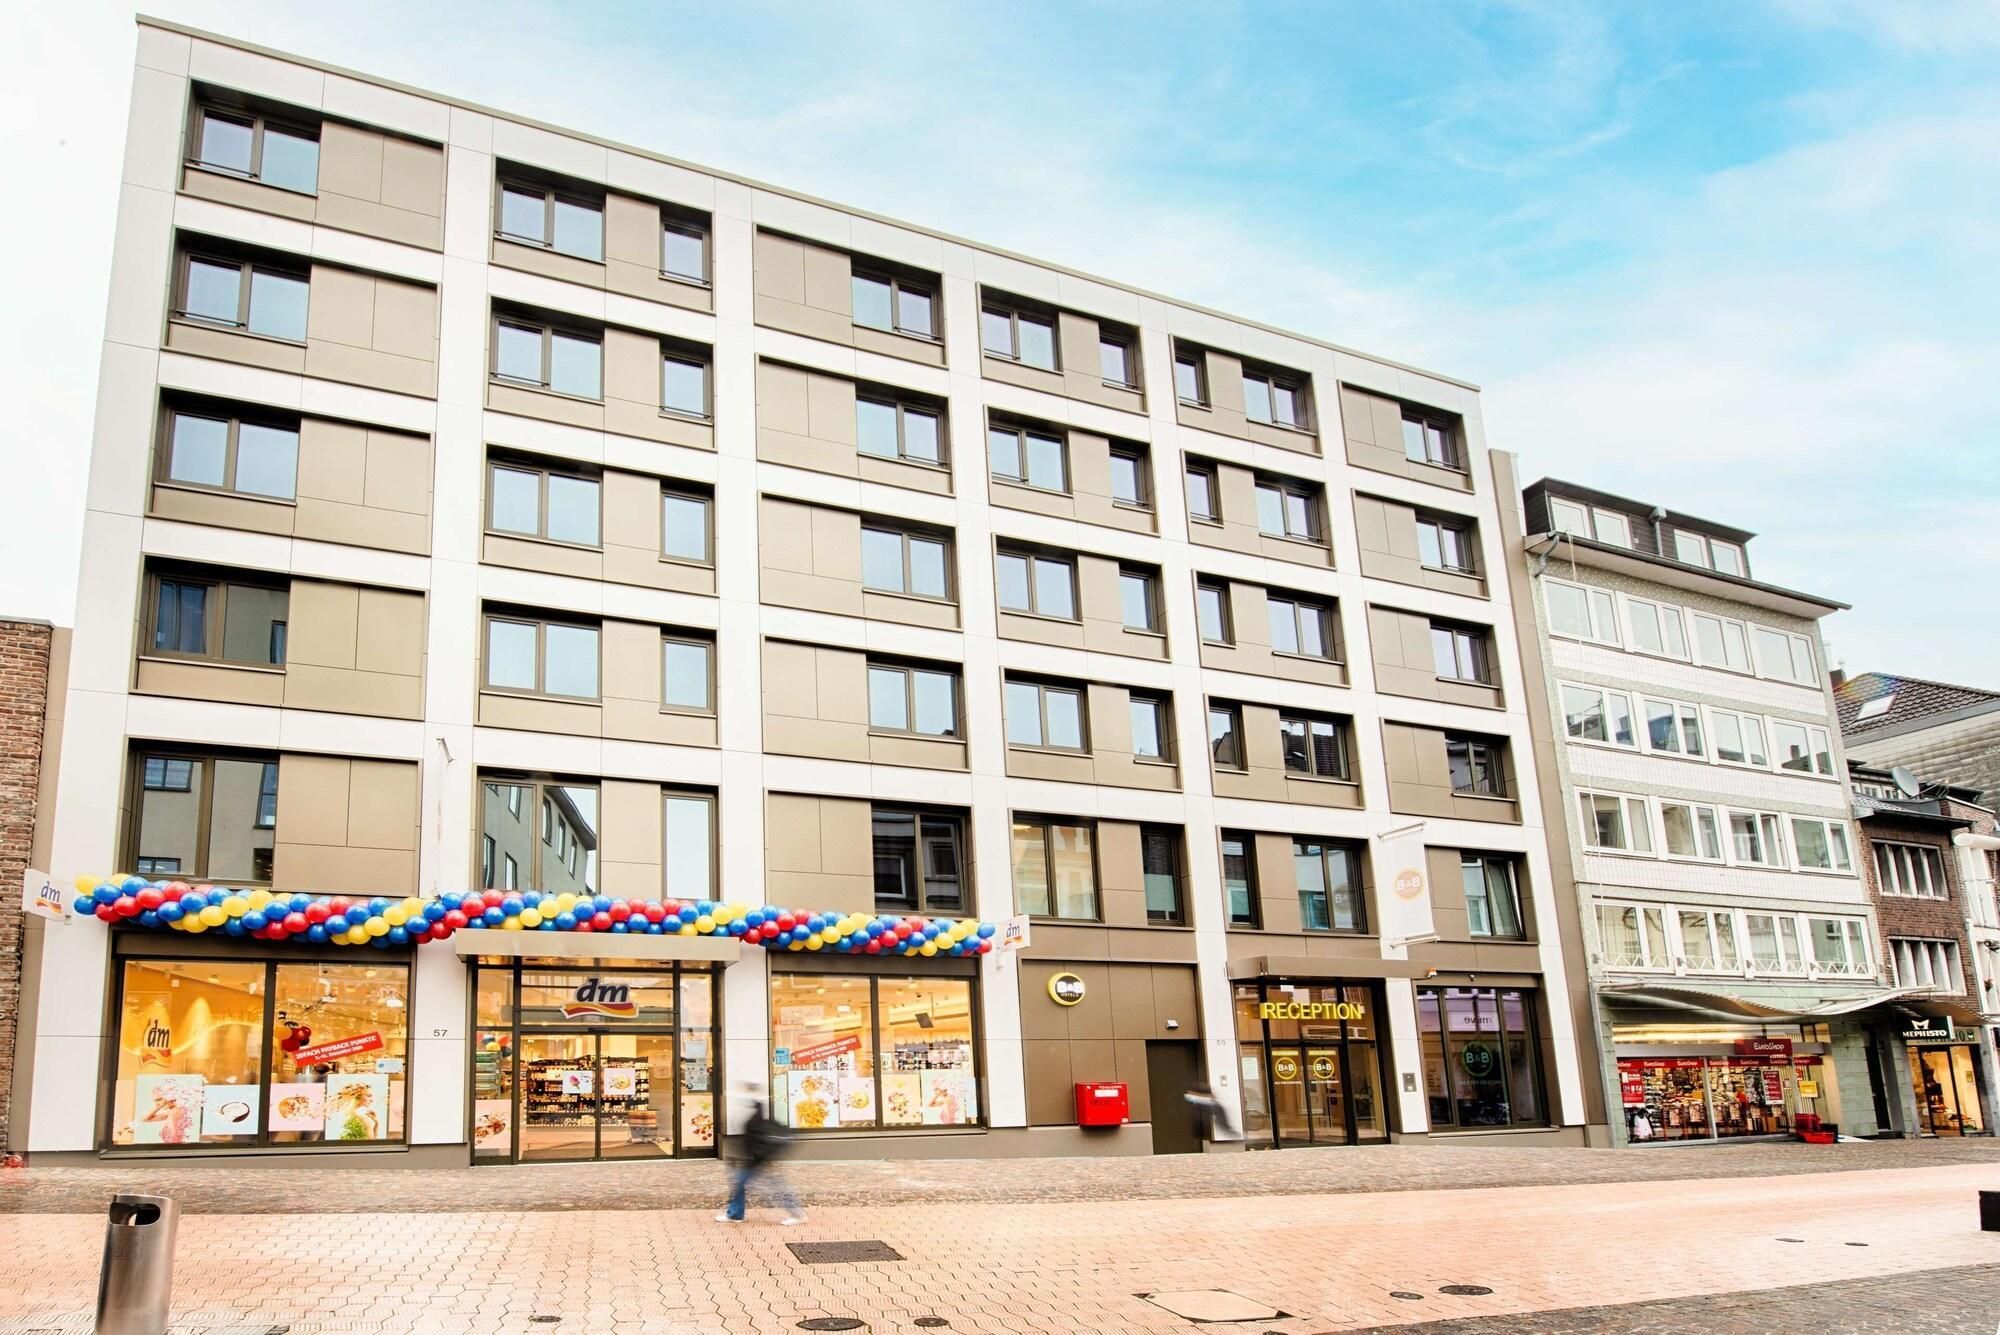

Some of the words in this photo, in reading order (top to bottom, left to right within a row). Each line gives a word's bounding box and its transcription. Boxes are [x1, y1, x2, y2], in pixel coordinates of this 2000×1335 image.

[40, 880, 61, 903] dm
[1006, 923, 1021, 938] dm
[576, 978, 629, 1002] dm
[1262, 1002, 1362, 1020] RECEPTION
[147, 1019, 170, 1048] dm
[433, 1029, 448, 1038] 57
[1902, 1029, 1947, 1037] MEPHISTO
[1753, 1042, 1785, 1052] EuroShop
[1465, 1052, 1490, 1063] B&B
[1278, 1063, 1295, 1072] B&B
[1315, 1063, 1333, 1071] B&B
